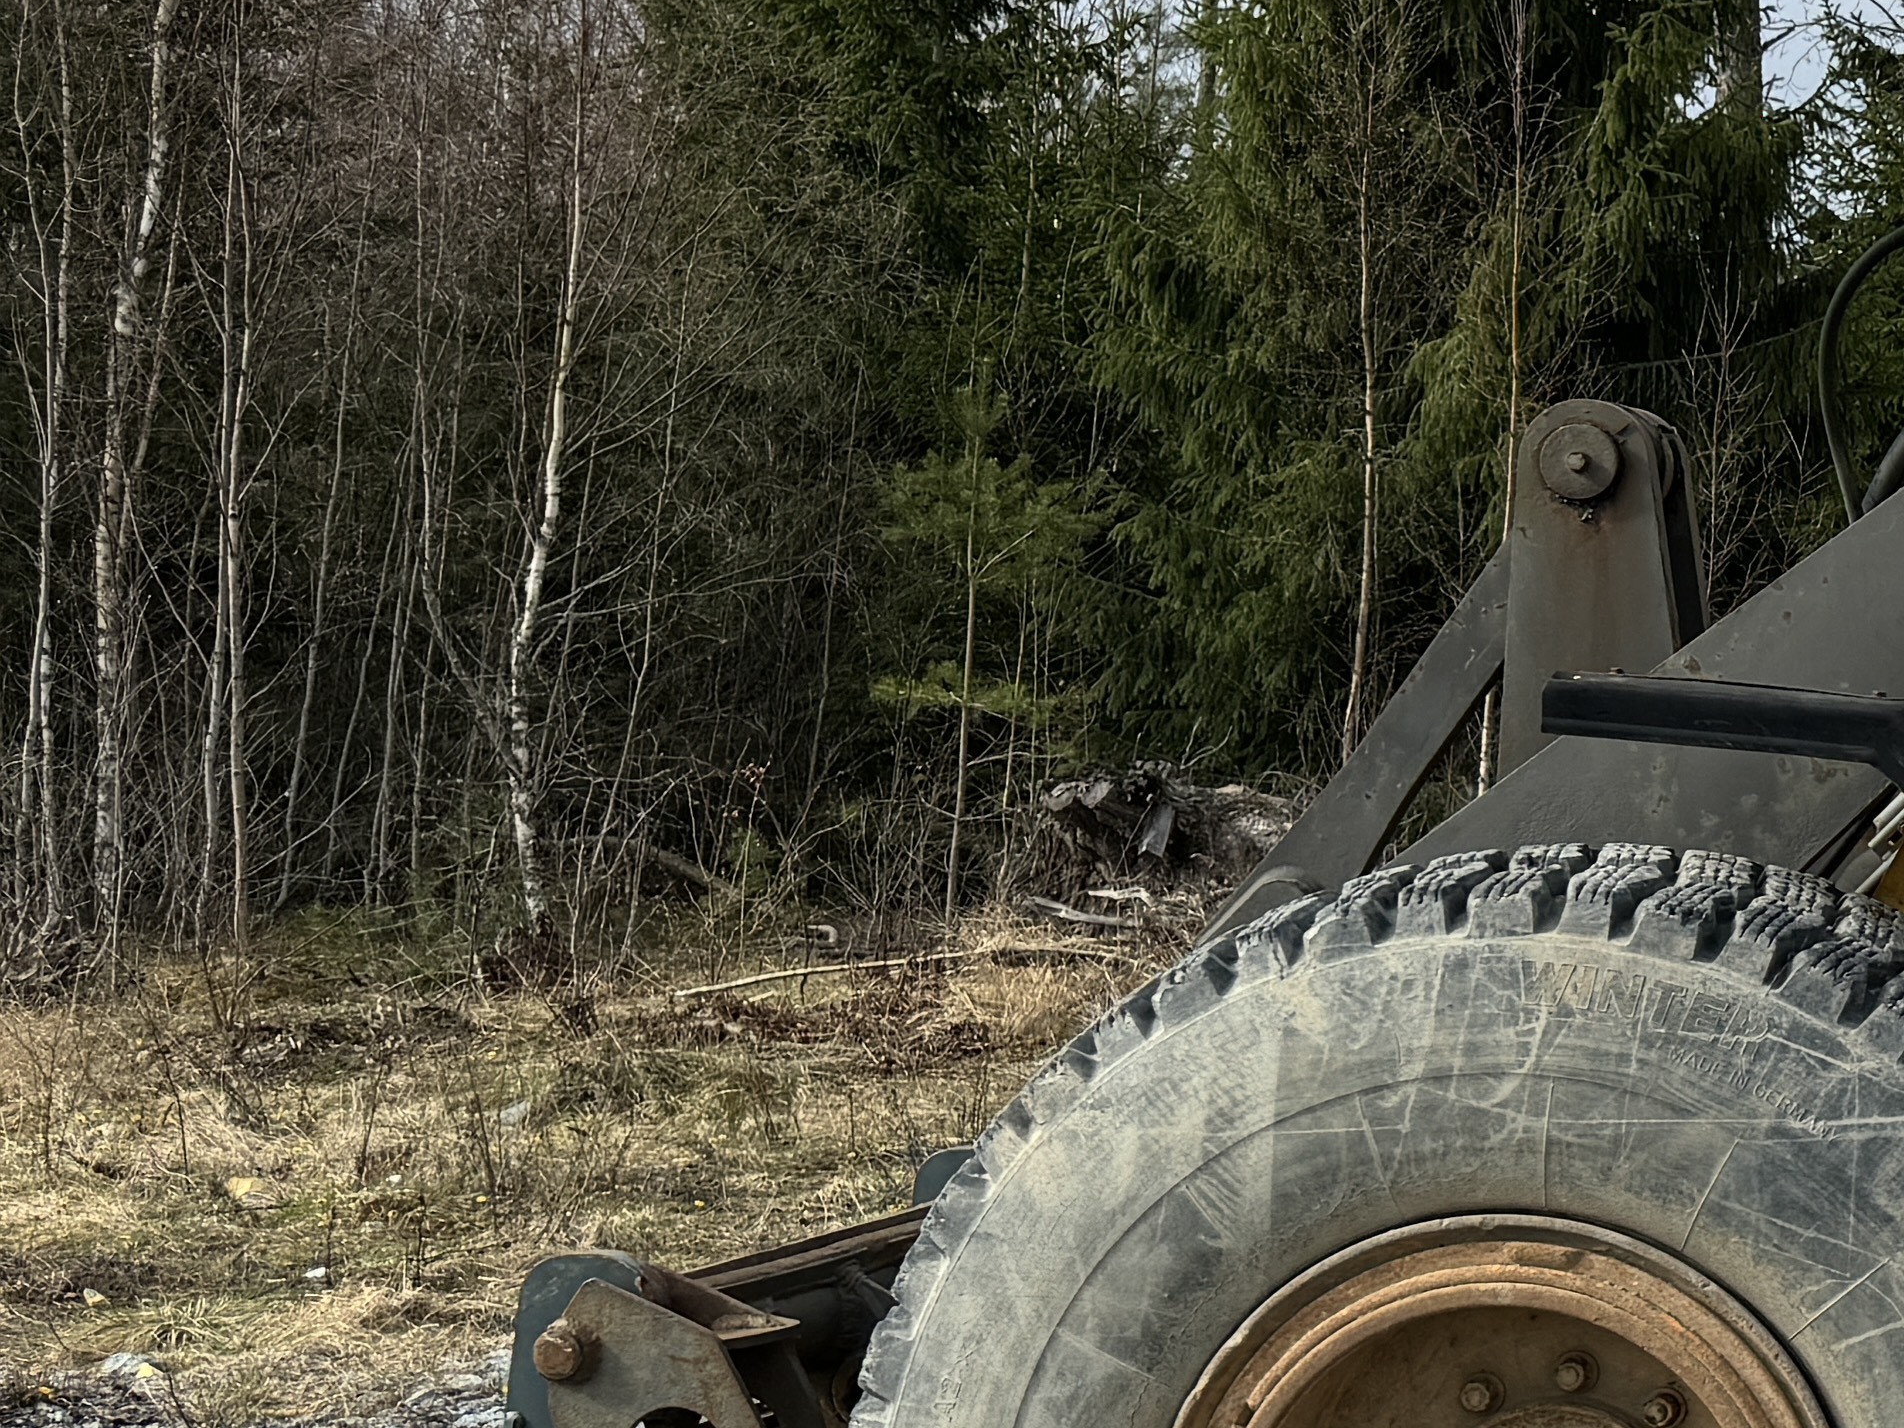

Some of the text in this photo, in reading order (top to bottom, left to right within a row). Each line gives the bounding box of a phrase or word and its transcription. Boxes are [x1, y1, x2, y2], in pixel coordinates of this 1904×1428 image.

[1520, 960, 1770, 1060] WINTER
[1728, 1070, 1750, 1091] IN
[1752, 1081, 1842, 1143] GERMANY
